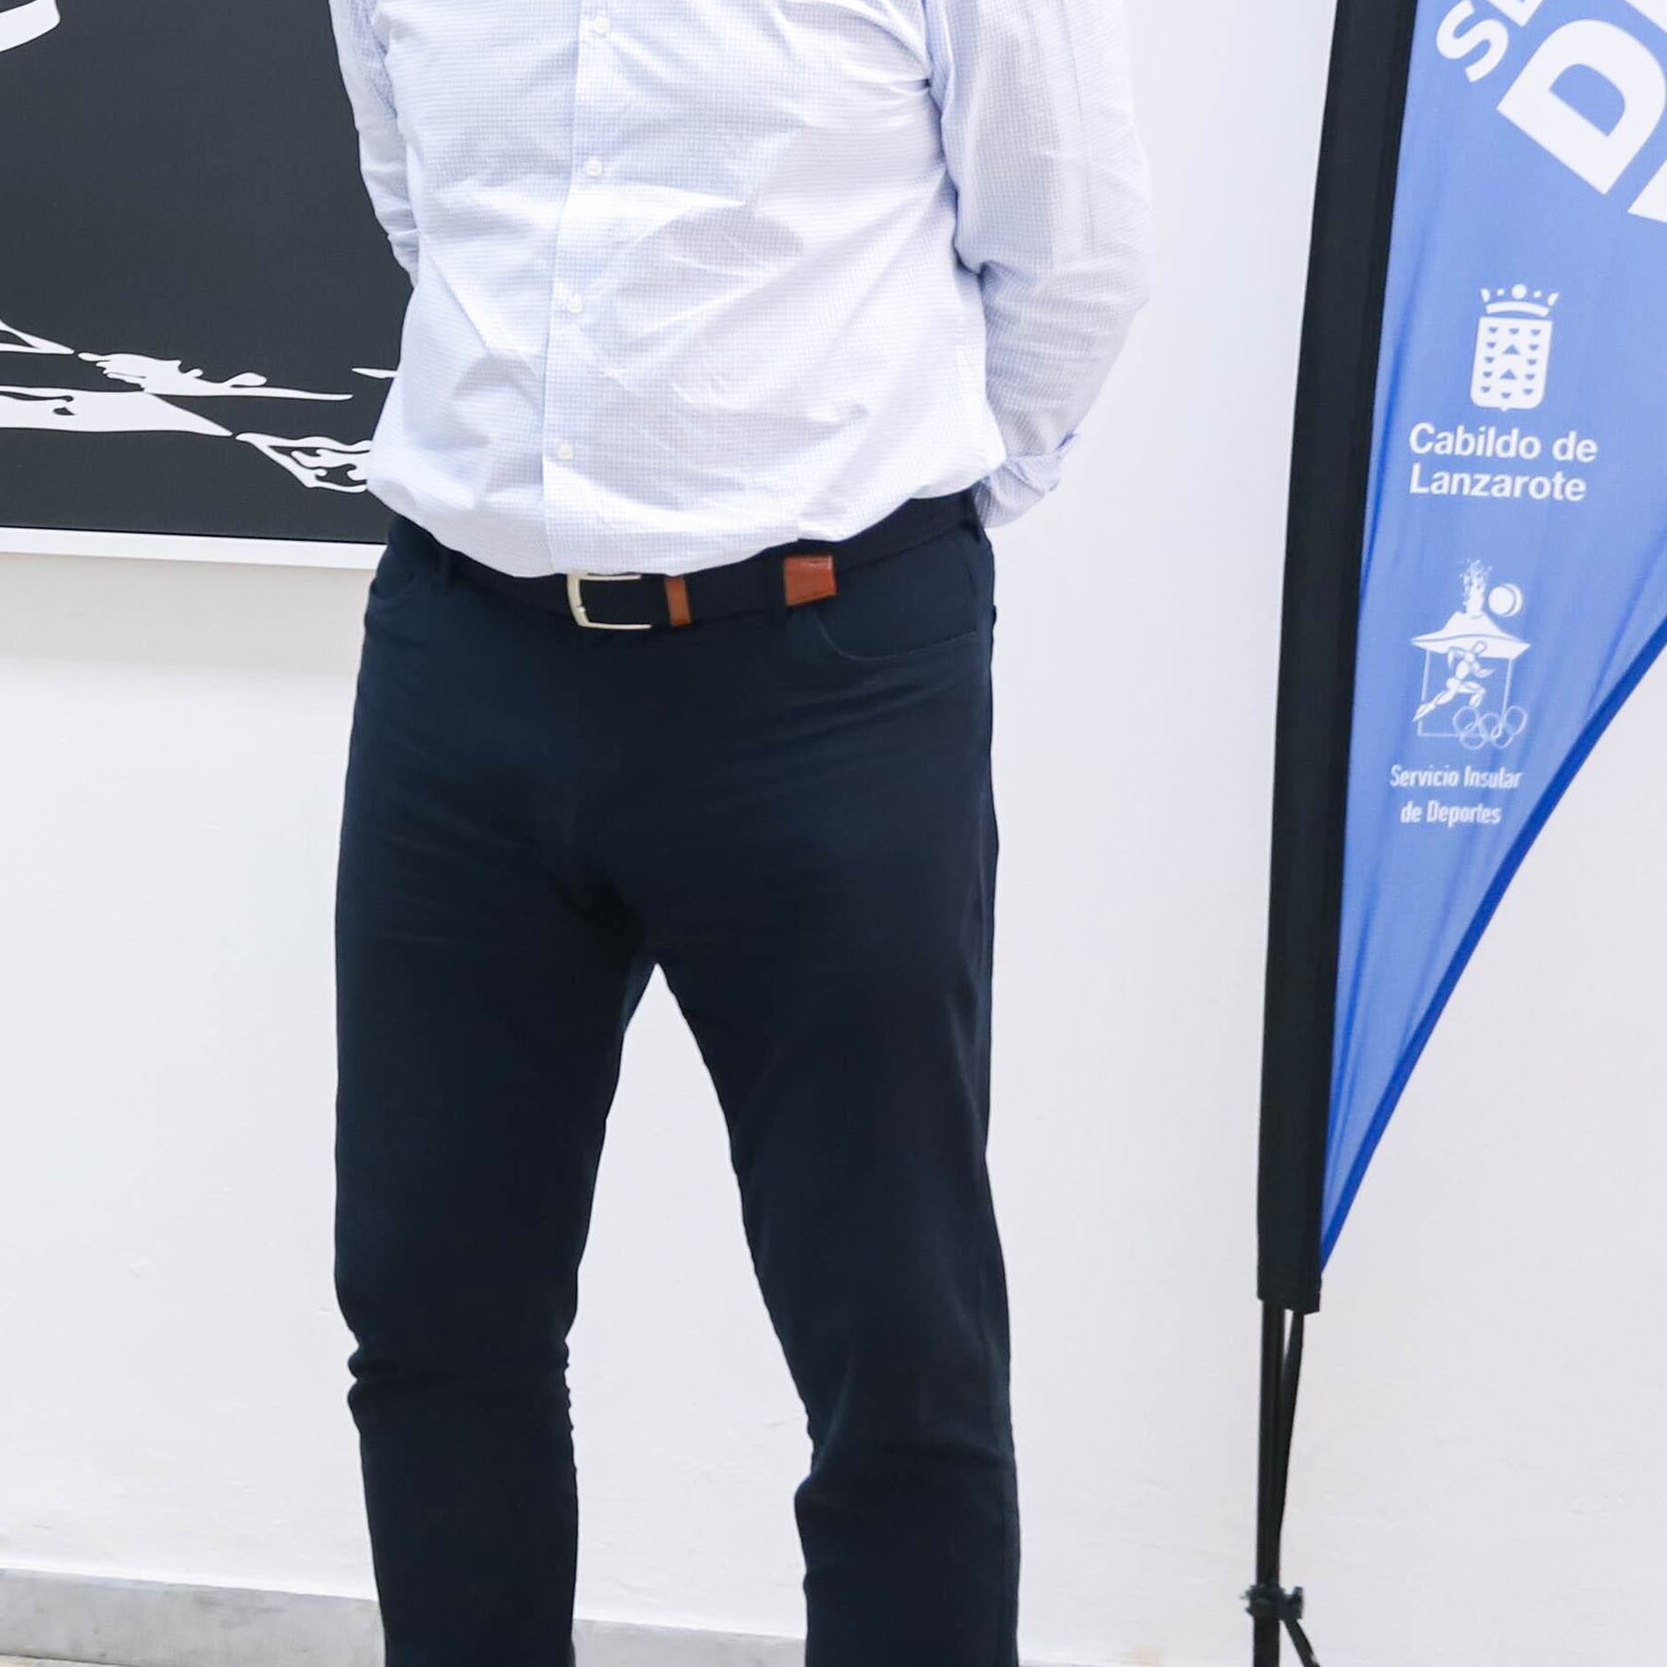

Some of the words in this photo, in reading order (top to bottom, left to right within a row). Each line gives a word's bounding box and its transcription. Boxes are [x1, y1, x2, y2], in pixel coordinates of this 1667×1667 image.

[1408, 422, 1541, 459] Cabildo
[1552, 430, 1598, 463] de
[1409, 463, 1587, 501] Lanzarote
[1389, 764, 1460, 789] Servicio
[1463, 765, 1523, 789] Insular
[1400, 800, 1422, 823] de
[1426, 799, 1502, 827] Deportes
